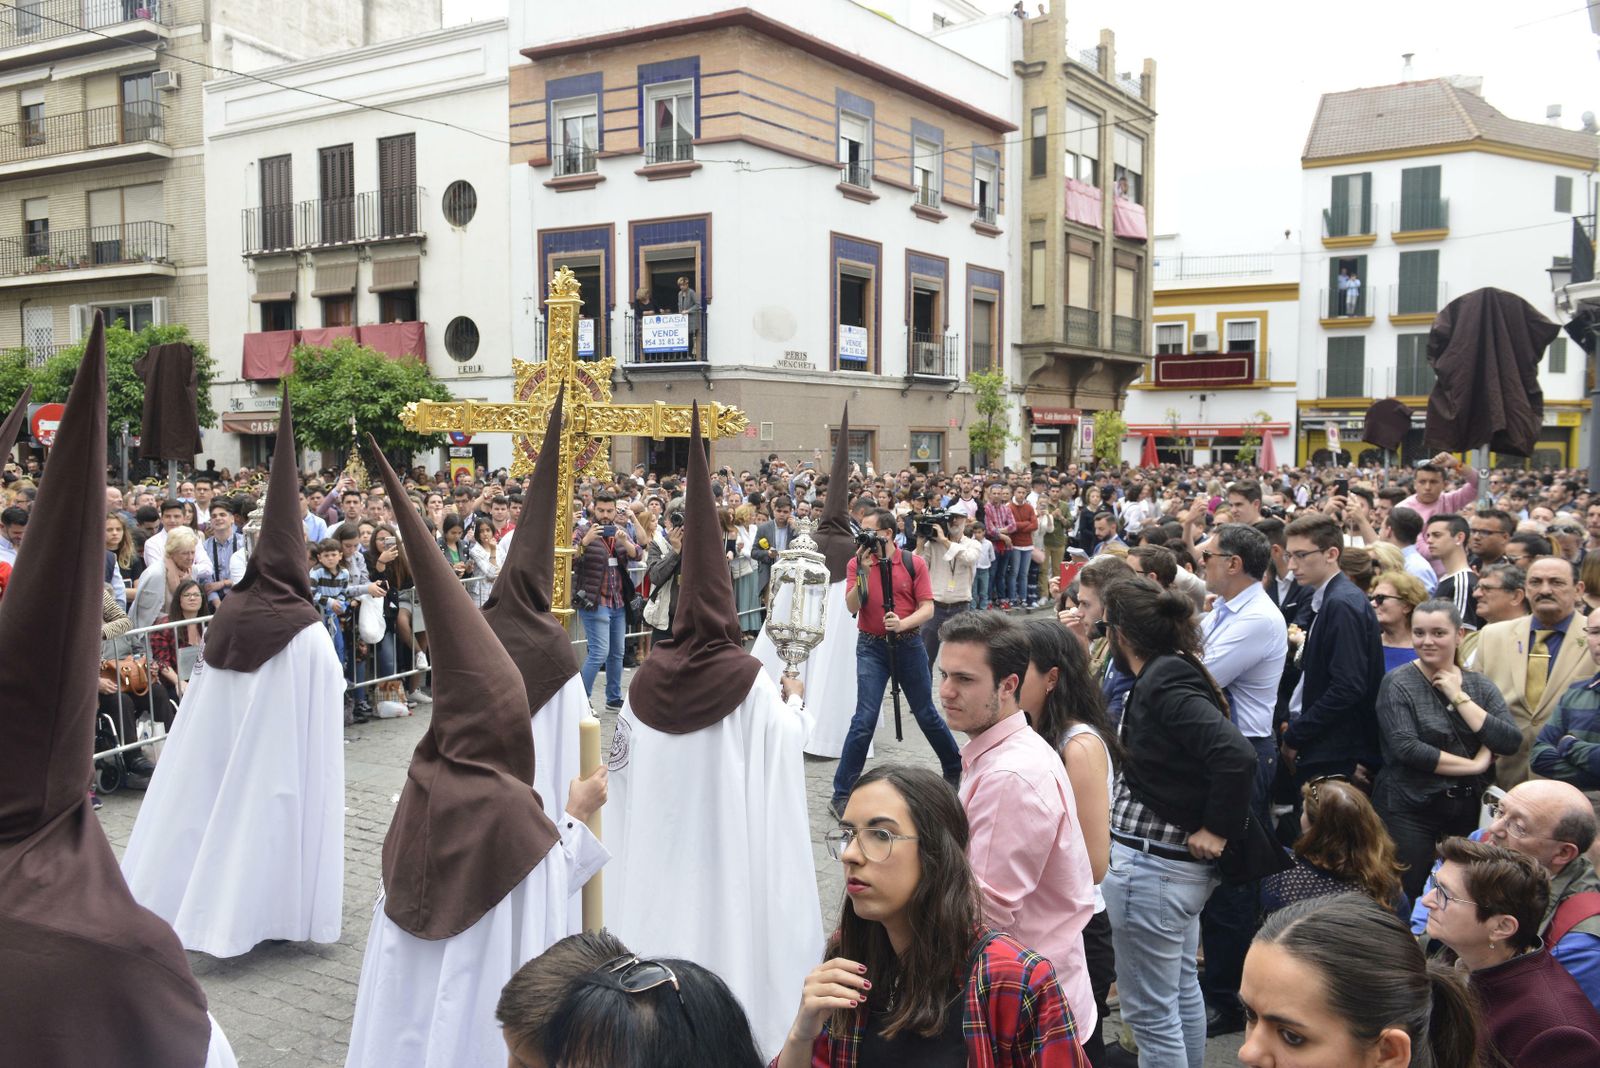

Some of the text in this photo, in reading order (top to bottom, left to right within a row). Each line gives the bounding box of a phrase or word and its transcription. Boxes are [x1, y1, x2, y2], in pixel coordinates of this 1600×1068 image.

[662, 316, 686, 324] CASA
[651, 329, 679, 337] VENDE
[785, 351, 808, 360] PERIS
[777, 360, 816, 369] MENCHETA
[250, 422, 274, 432] CASA
